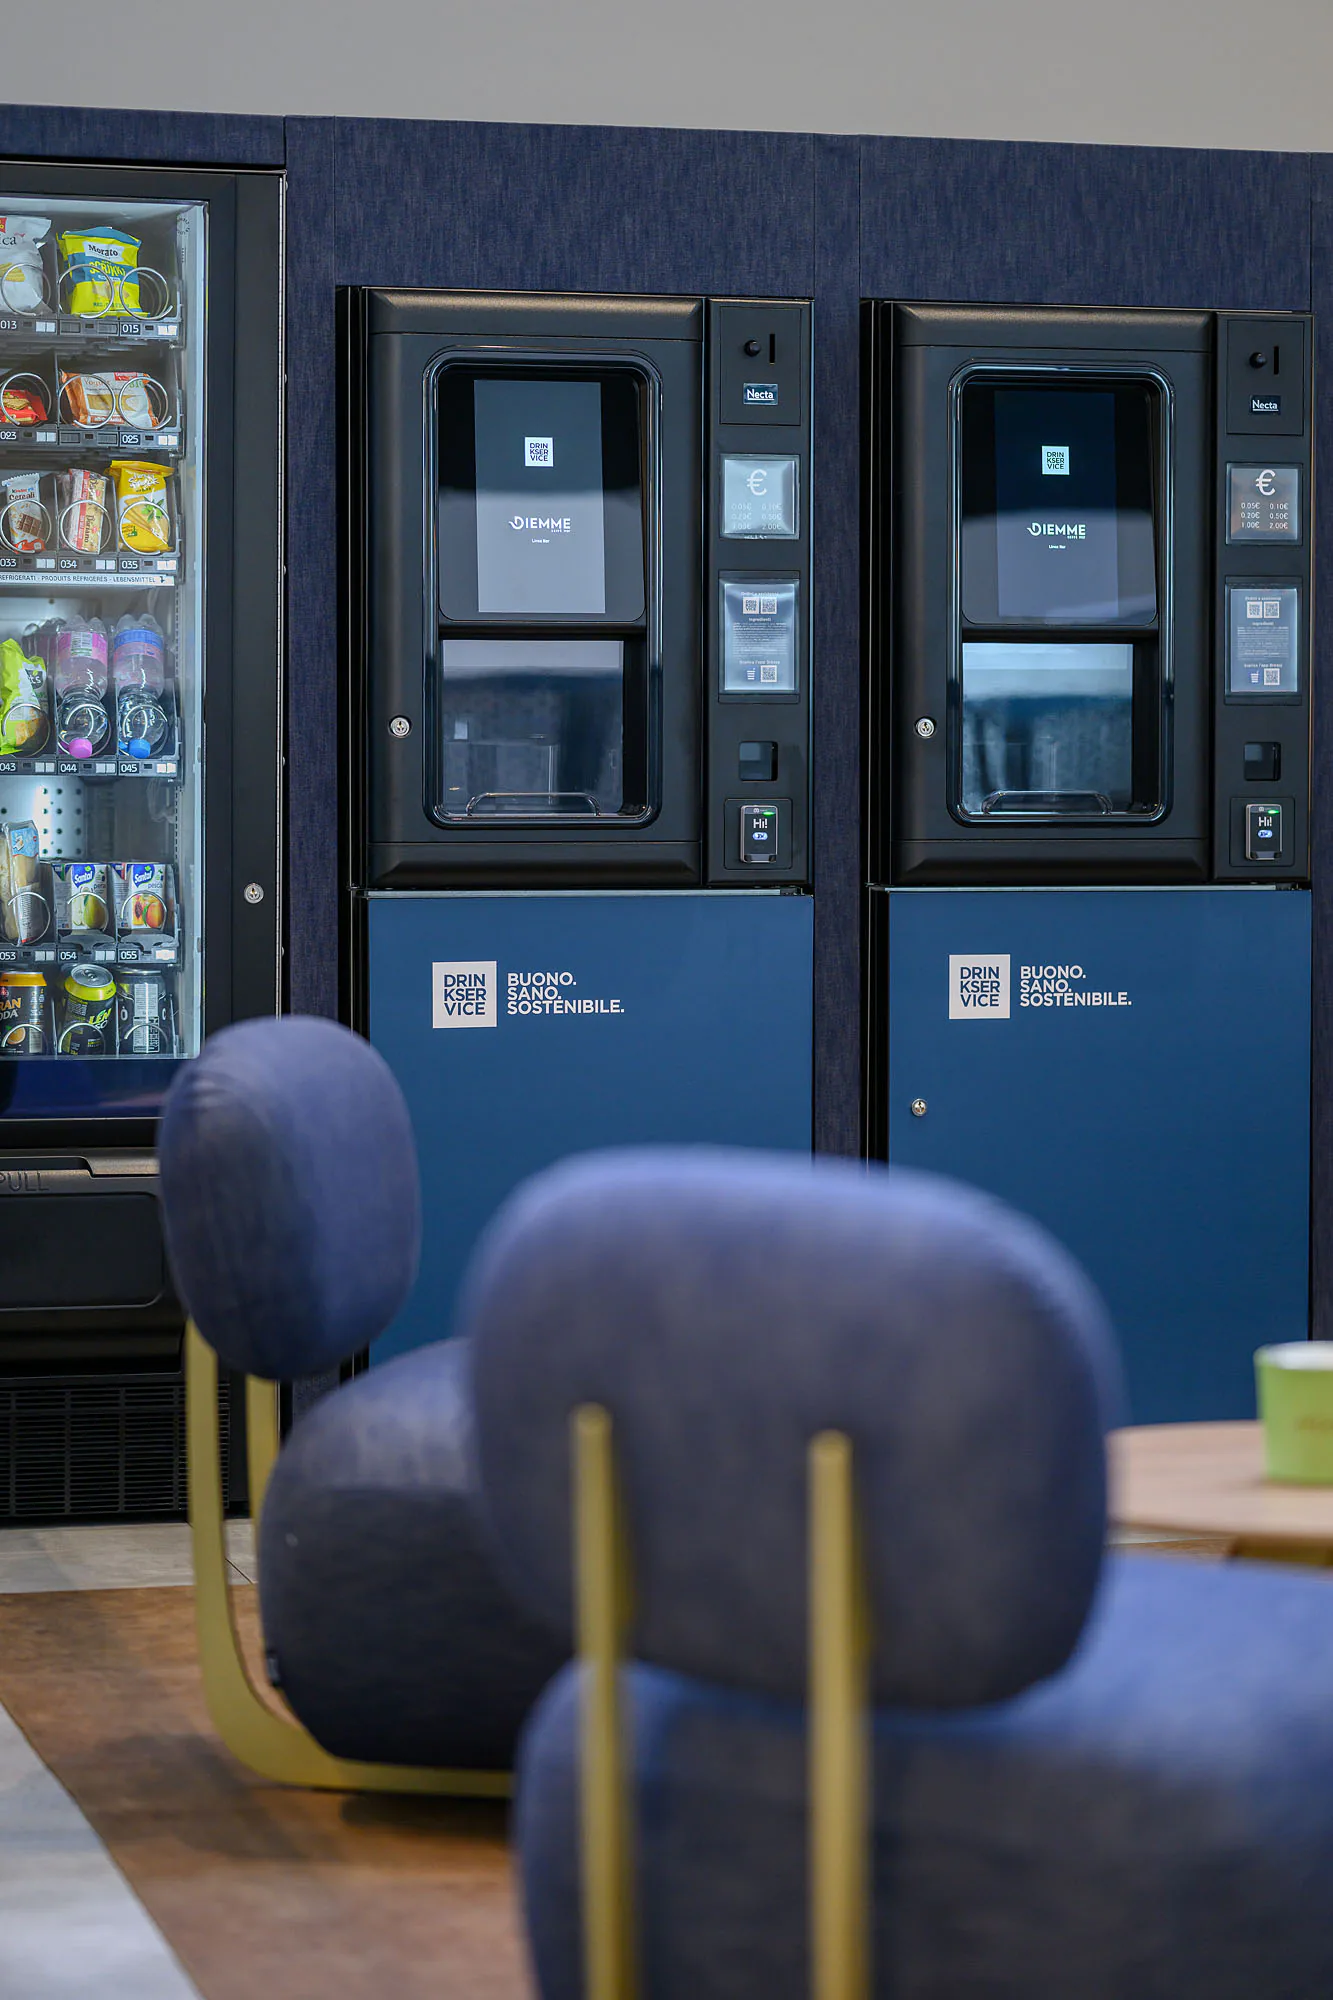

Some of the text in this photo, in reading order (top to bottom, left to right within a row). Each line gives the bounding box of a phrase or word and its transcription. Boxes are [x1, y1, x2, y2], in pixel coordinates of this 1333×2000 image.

[88, 244, 118, 256] Morato
[0, 320, 17, 330] 013
[122, 324, 139, 333] 015
[747, 388, 774, 400] Necta
[1252, 400, 1278, 410] Necta
[0, 431, 16, 440] 023
[122, 435, 139, 444] 025
[746, 468, 767, 496] €
[1256, 469, 1276, 496] €
[508, 516, 570, 530] DIEMME
[1027, 522, 1086, 536] DIEMME
[0, 559, 16, 567] 033
[60, 560, 77, 568] 034
[122, 561, 138, 569] 035
[0, 763, 16, 771] 043
[60, 764, 77, 772] 044
[121, 764, 137, 772] 045
[753, 818, 768, 828] Hi!
[1258, 816, 1272, 826] Hi!
[74, 871, 93, 884] Santal
[134, 870, 152, 884] Santal
[0, 952, 16, 960] 053
[60, 952, 77, 960] 054
[121, 951, 137, 959] 055
[960, 966, 1000, 979] DRIN
[1020, 965, 1086, 979] BUONO.
[444, 973, 486, 988] DRIN
[507, 972, 576, 986] BUONO.
[960, 980, 1000, 993] KSER
[1020, 979, 1072, 992] SANO.
[444, 988, 486, 1001] KSER
[507, 986, 562, 1001] SANO.
[1020, 992, 1132, 1007] SOSTENIBILE.
[960, 994, 999, 1007] VICE
[444, 1002, 485, 1016] VICE
[507, 1000, 624, 1015] SOSTENIBILE.
